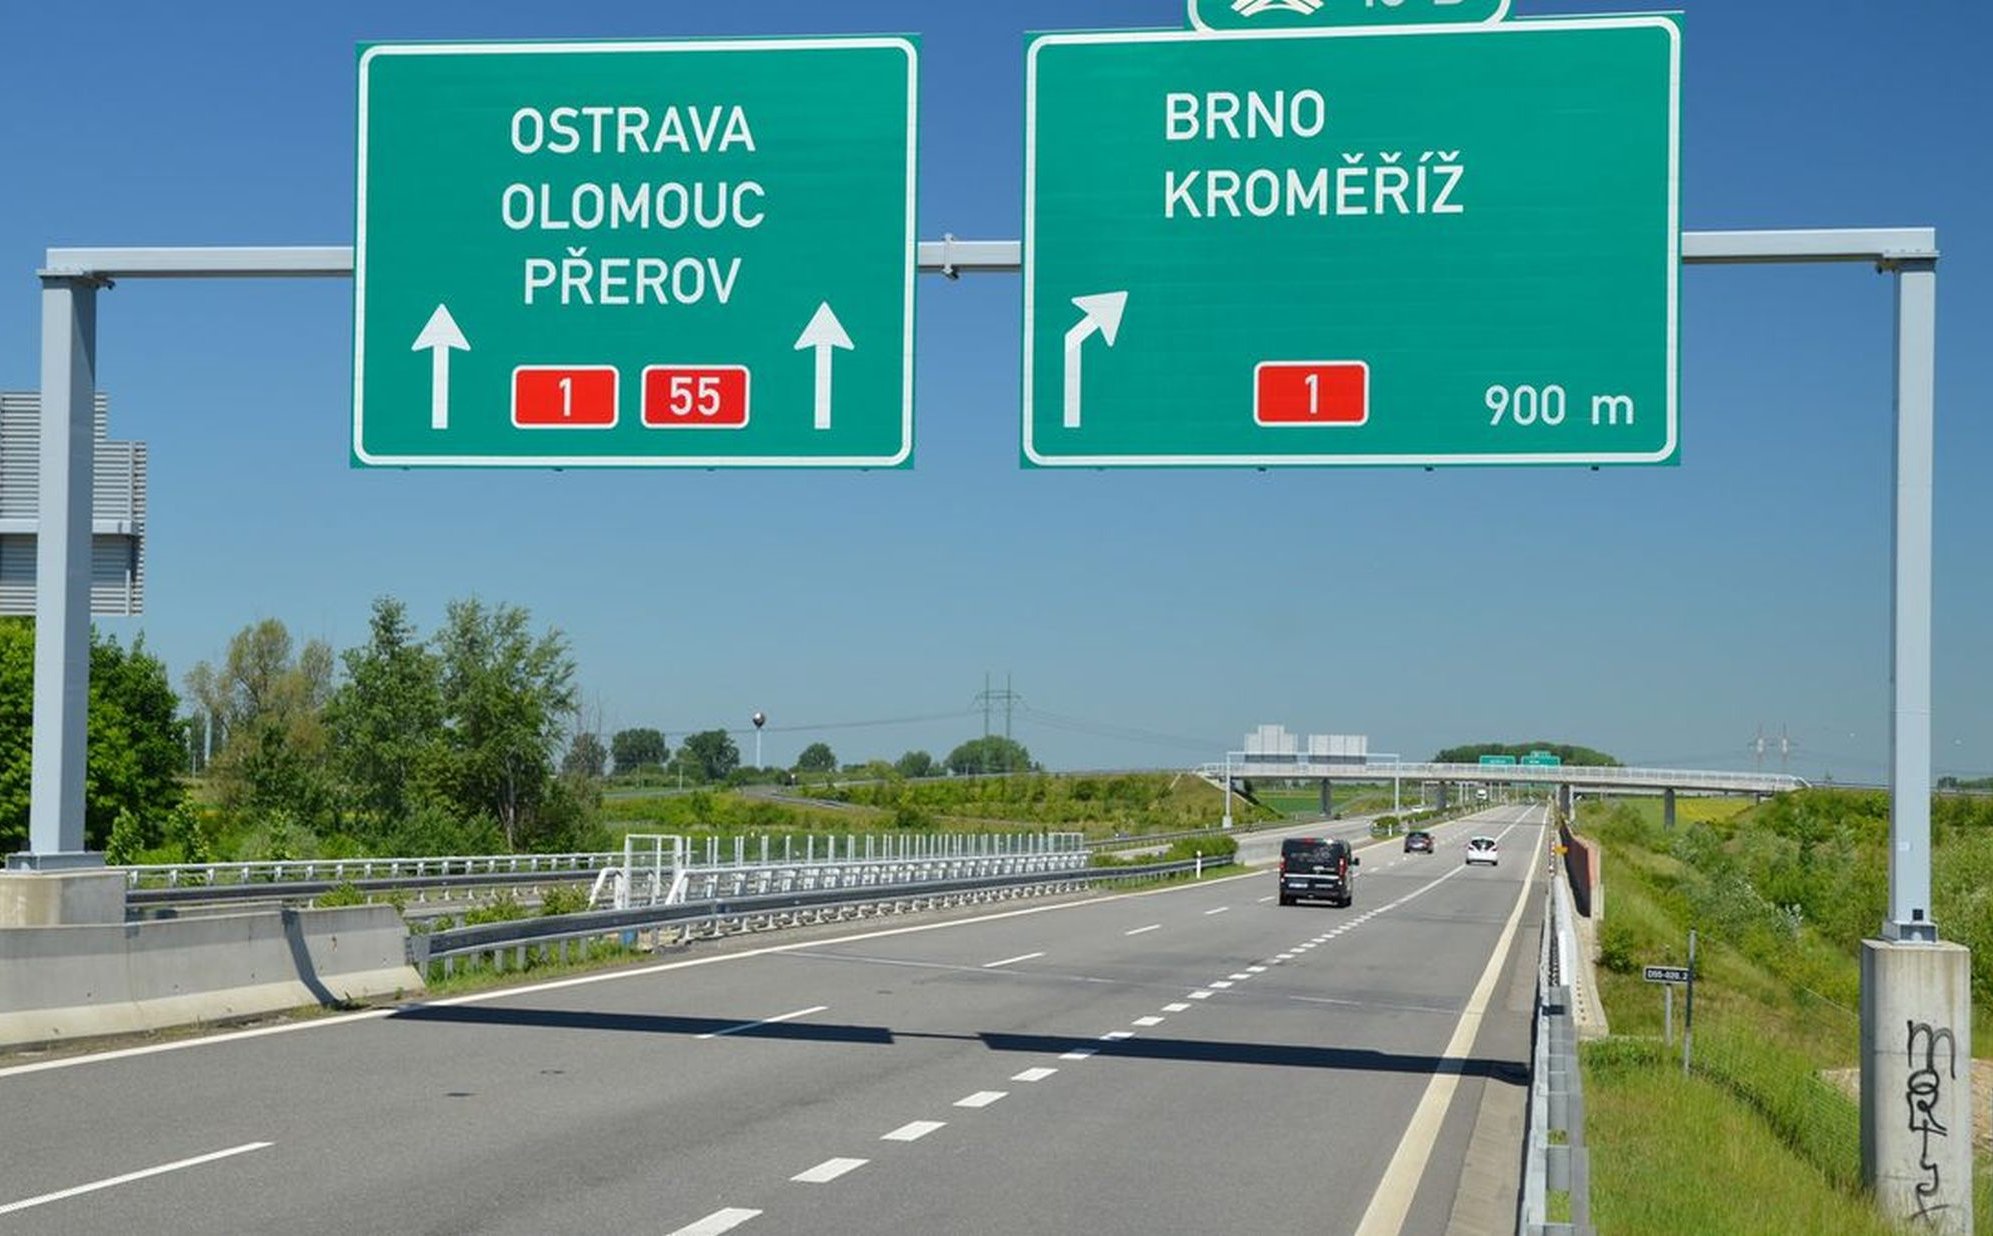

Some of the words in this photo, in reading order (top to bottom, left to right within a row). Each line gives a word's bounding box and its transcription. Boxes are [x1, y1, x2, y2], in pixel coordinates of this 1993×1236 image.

[511, 105, 756, 154] OSTRAVA
[1166, 89, 1325, 141] BRNO
[502, 181, 766, 230] OLOMOUC
[1165, 150, 1465, 218] KROMĚŘÍŽ
[524, 246, 742, 305] PŘEROV
[558, 377, 573, 417] 1
[669, 376, 721, 416] 55
[1304, 373, 1319, 414] 1
[1485, 384, 1567, 426] 900
[1591, 395, 1634, 425] m
